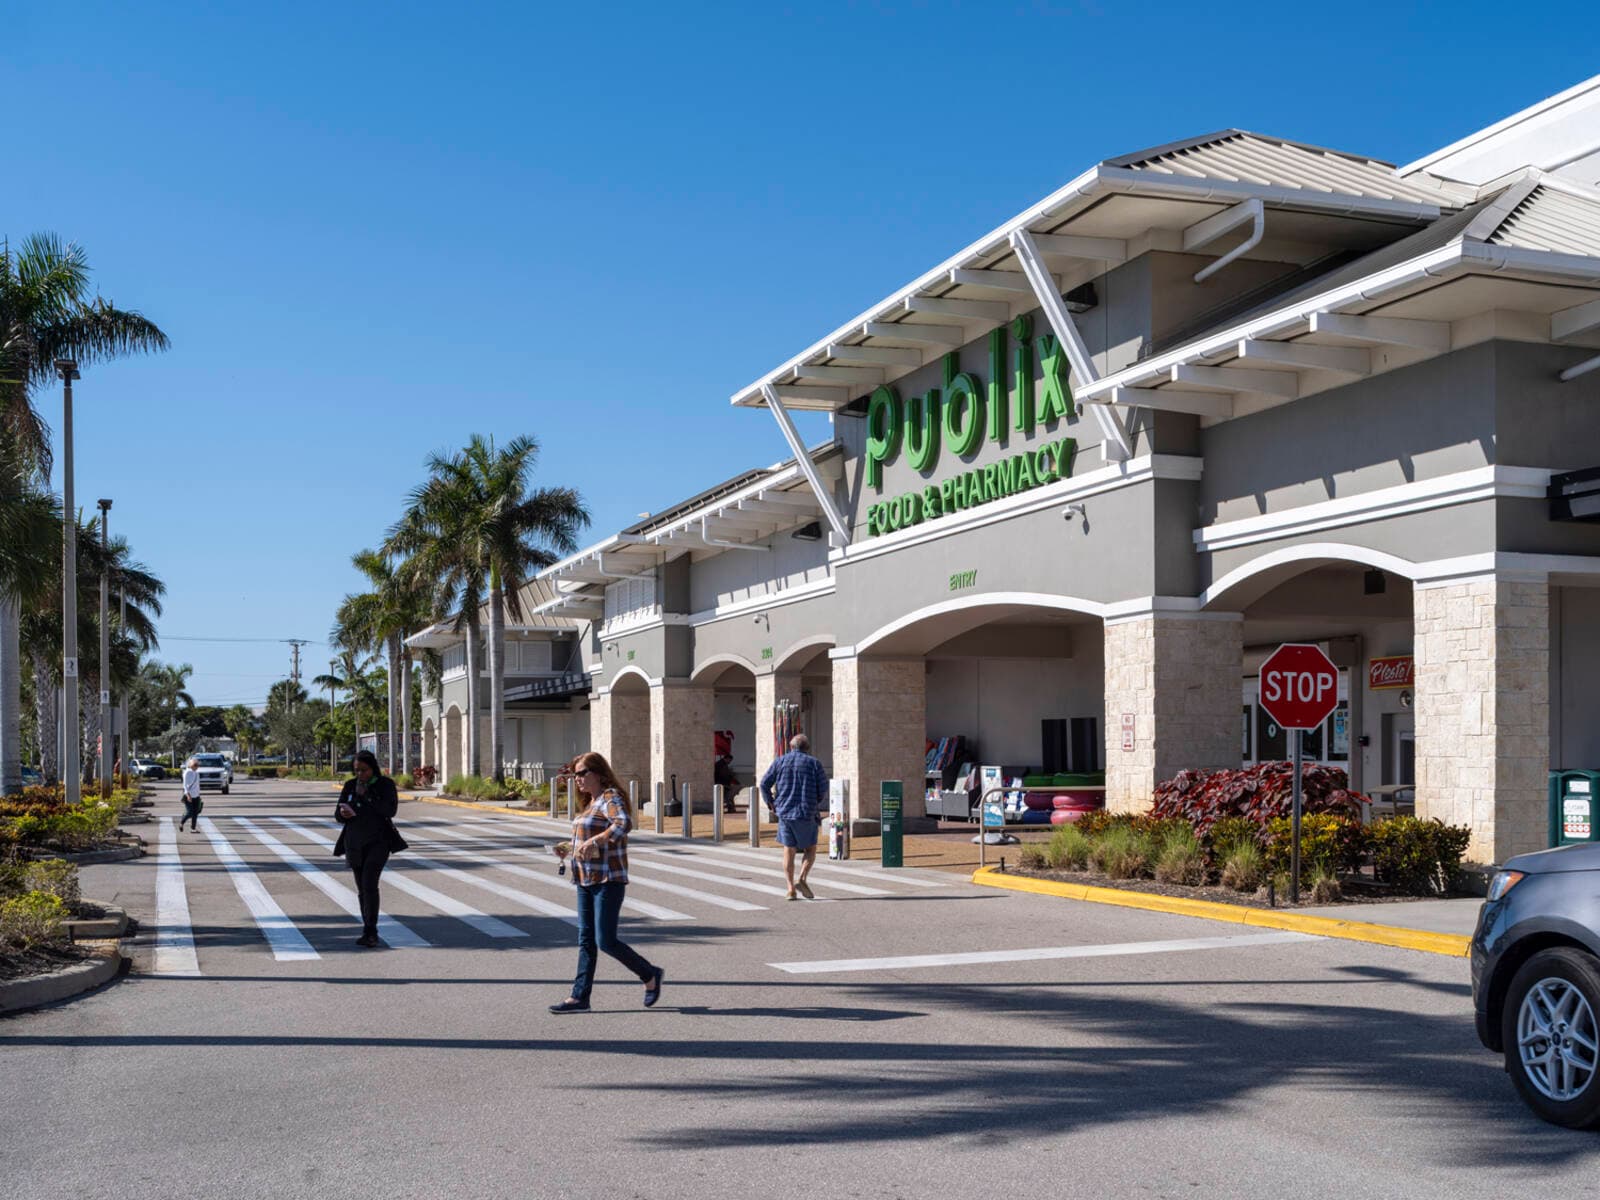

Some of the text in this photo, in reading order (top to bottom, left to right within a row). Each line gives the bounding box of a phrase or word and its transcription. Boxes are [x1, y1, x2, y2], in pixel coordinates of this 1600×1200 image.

[866, 314, 1075, 488] Publix
[866, 437, 1077, 536] FOOD & PHARMACY
[949, 569, 977, 591] ENTRY
[1265, 671, 1333, 703] STOP
